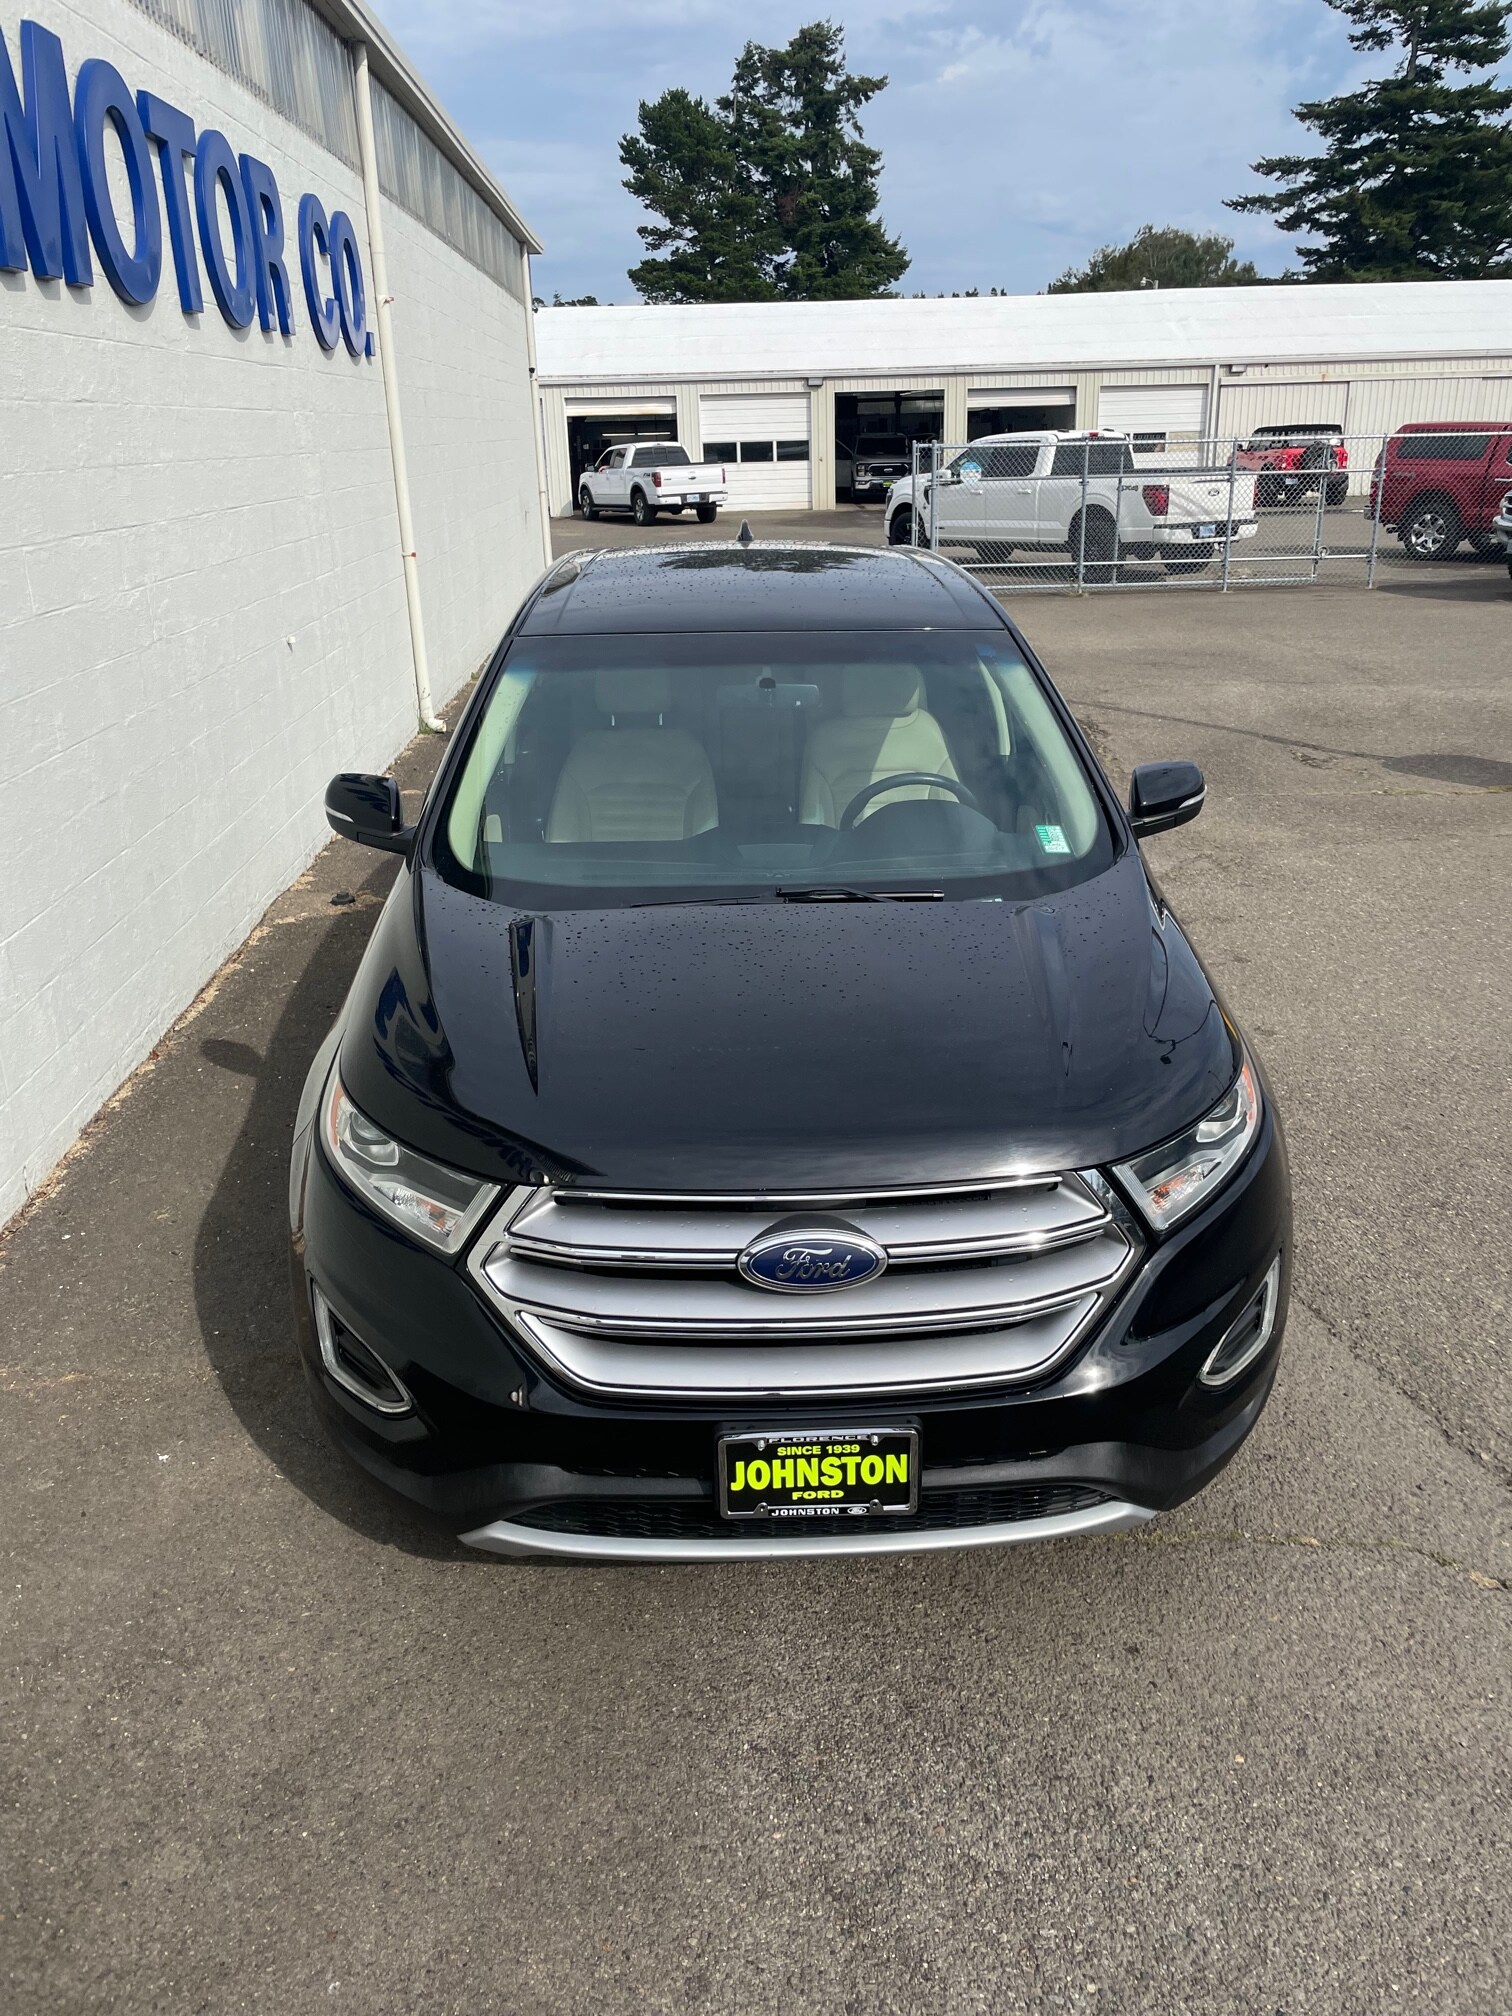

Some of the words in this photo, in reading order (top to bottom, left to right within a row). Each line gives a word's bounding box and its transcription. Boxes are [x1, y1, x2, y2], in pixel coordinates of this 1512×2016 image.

[0, 18, 297, 337] MOTOR
[299, 192, 376, 358] CO.
[775, 1247, 853, 1280] Ford
[768, 1434, 869, 1444] FLORENCE
[777, 1445, 822, 1456] SINCE
[825, 1444, 861, 1454] 1939
[730, 1454, 908, 1492] JOHNSTON
[792, 1490, 845, 1500] FORD
[771, 1507, 840, 1516] JOHNSTON
